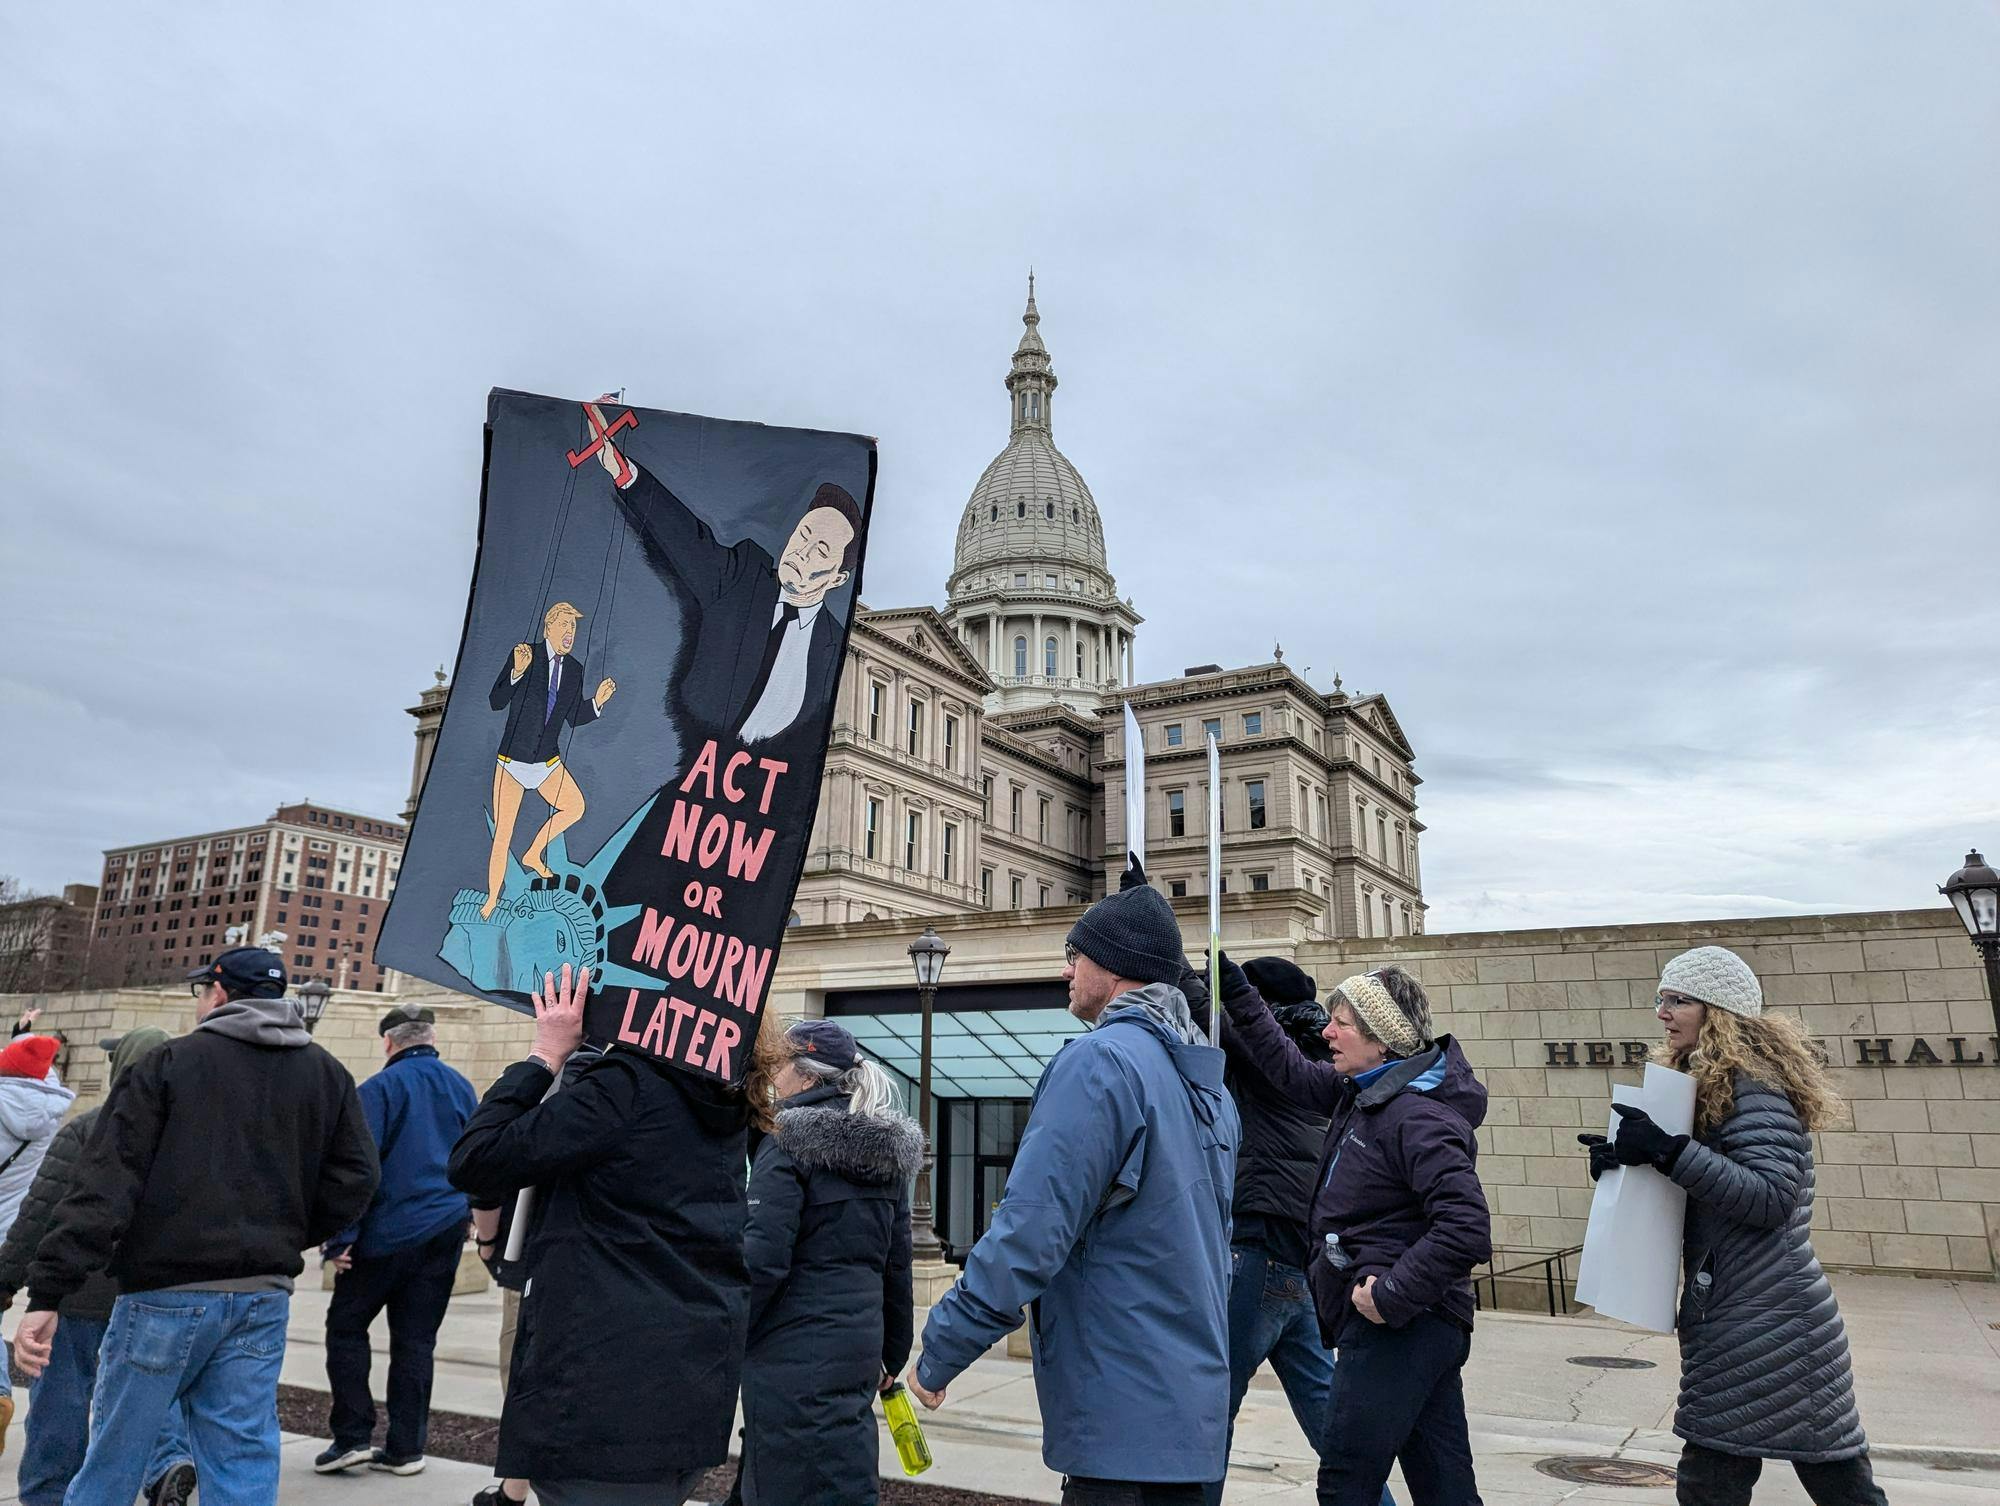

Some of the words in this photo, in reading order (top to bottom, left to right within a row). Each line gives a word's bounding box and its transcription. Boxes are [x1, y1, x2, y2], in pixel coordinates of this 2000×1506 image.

[680, 740, 788, 814] ACT
[661, 799, 776, 882] NOW
[683, 881, 722, 918] OR
[631, 907, 772, 1014] MOURN
[617, 989, 741, 1081] LATER
[1853, 1037, 1999, 1064] HAL
